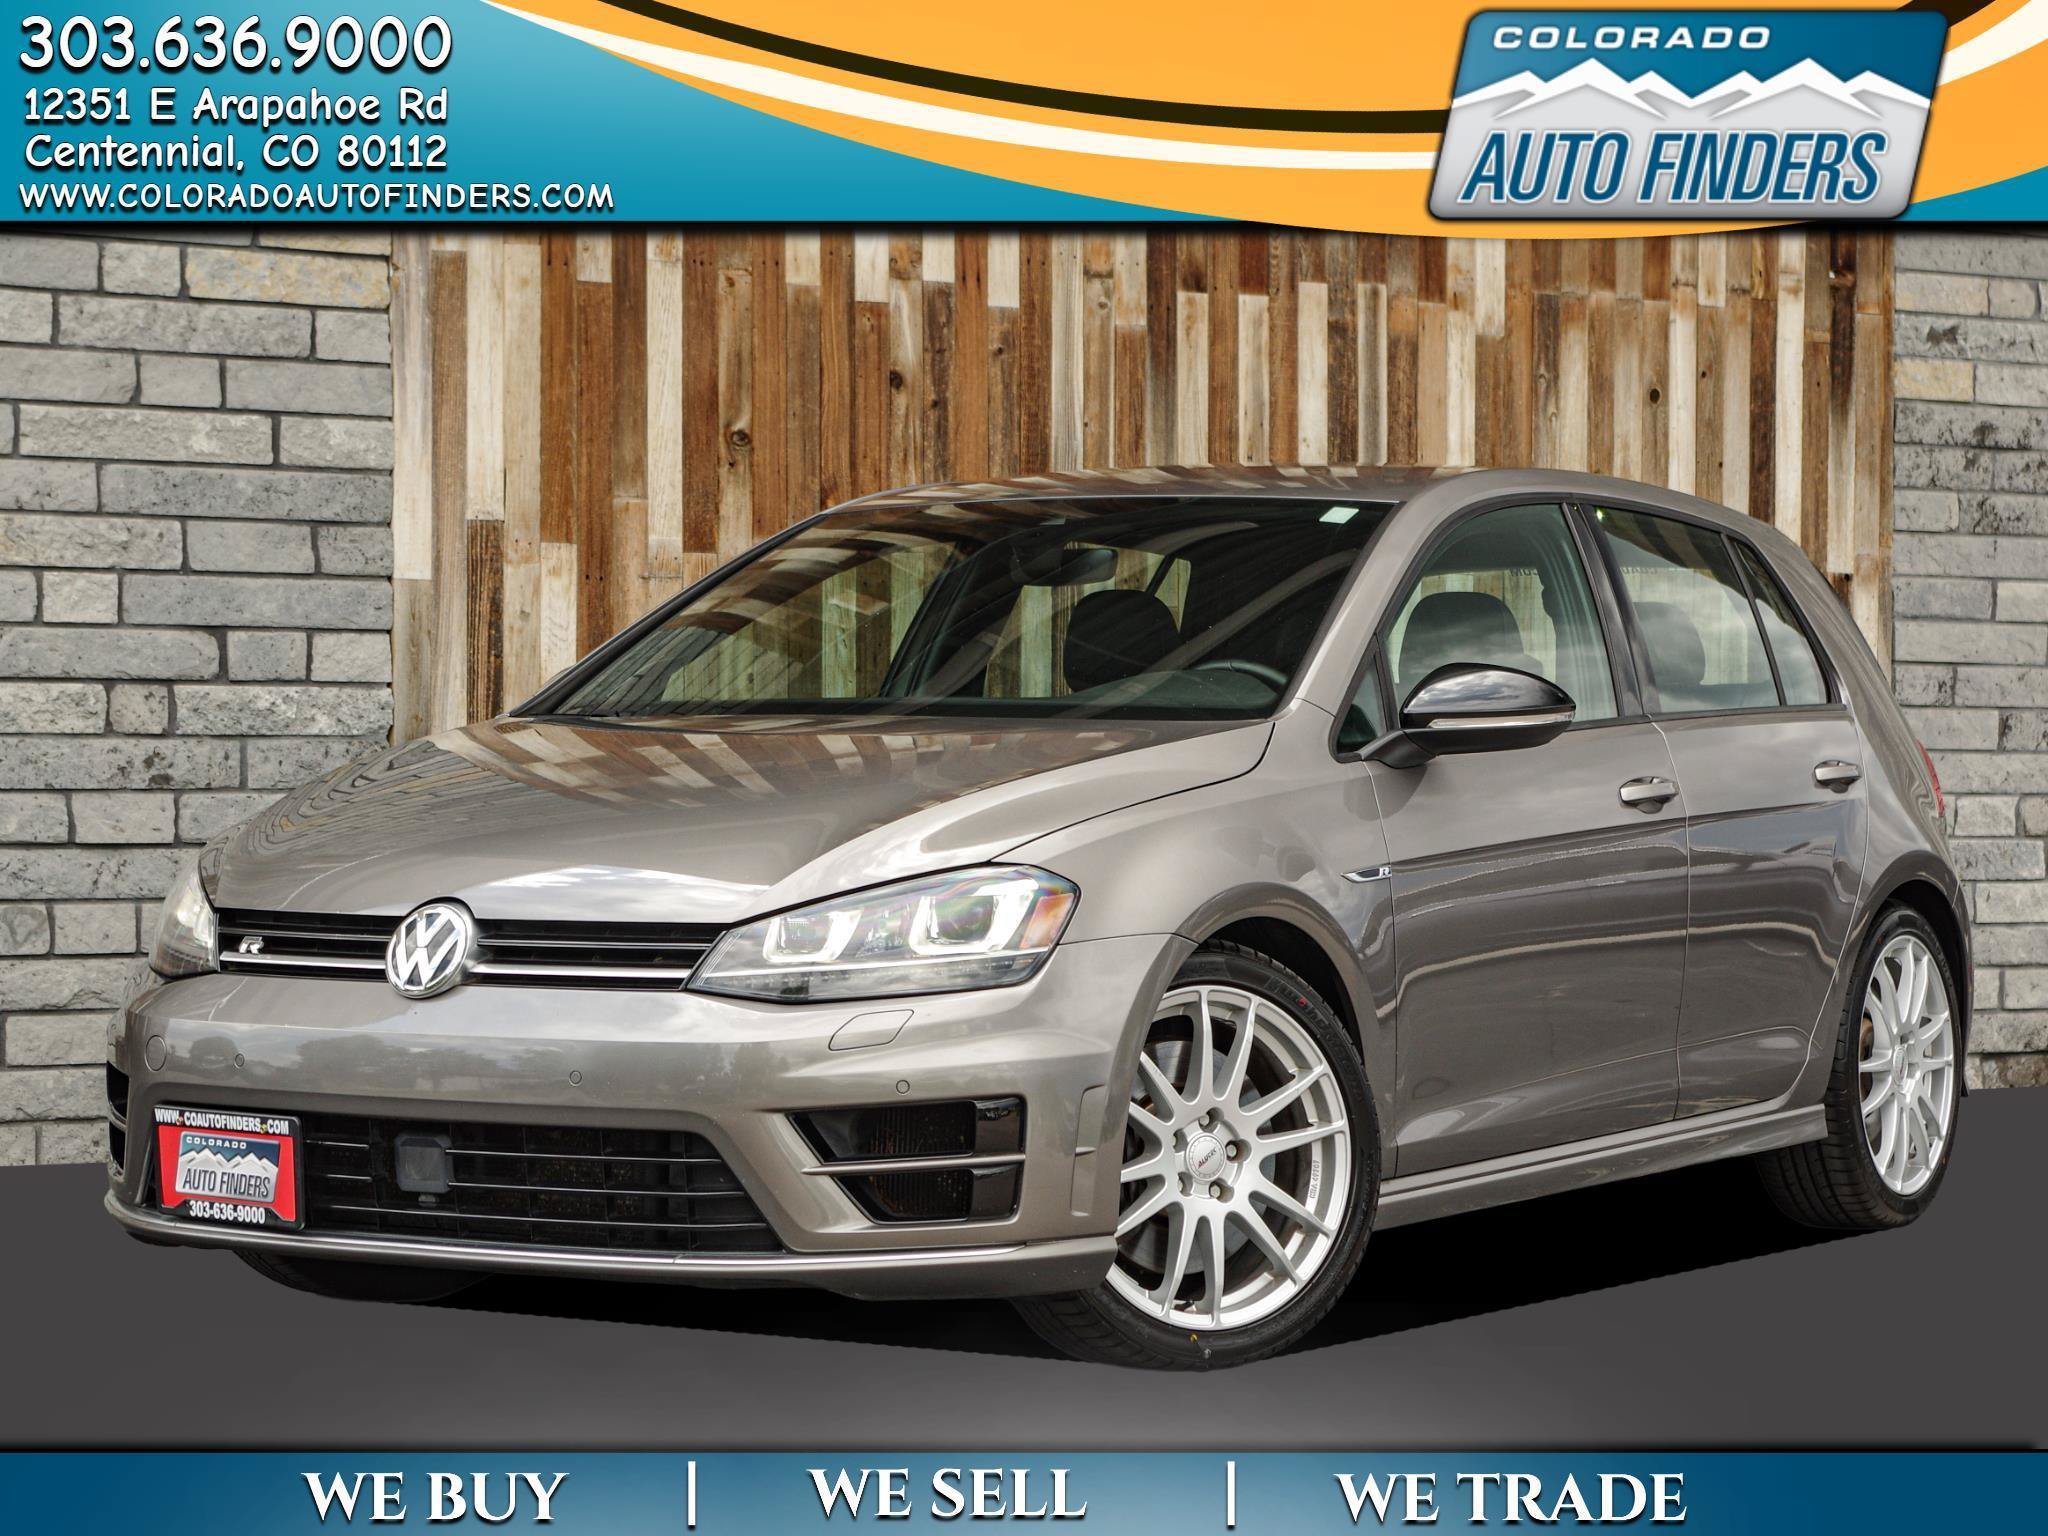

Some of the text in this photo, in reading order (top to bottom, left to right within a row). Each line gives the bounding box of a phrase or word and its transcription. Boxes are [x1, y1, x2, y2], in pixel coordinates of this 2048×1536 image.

[238, 936, 264, 954] R
[185, 1136, 247, 1149] COLORADO
[182, 1168, 271, 1198] AUTO FINDERS
[189, 1200, 265, 1224] 303-636-9000
